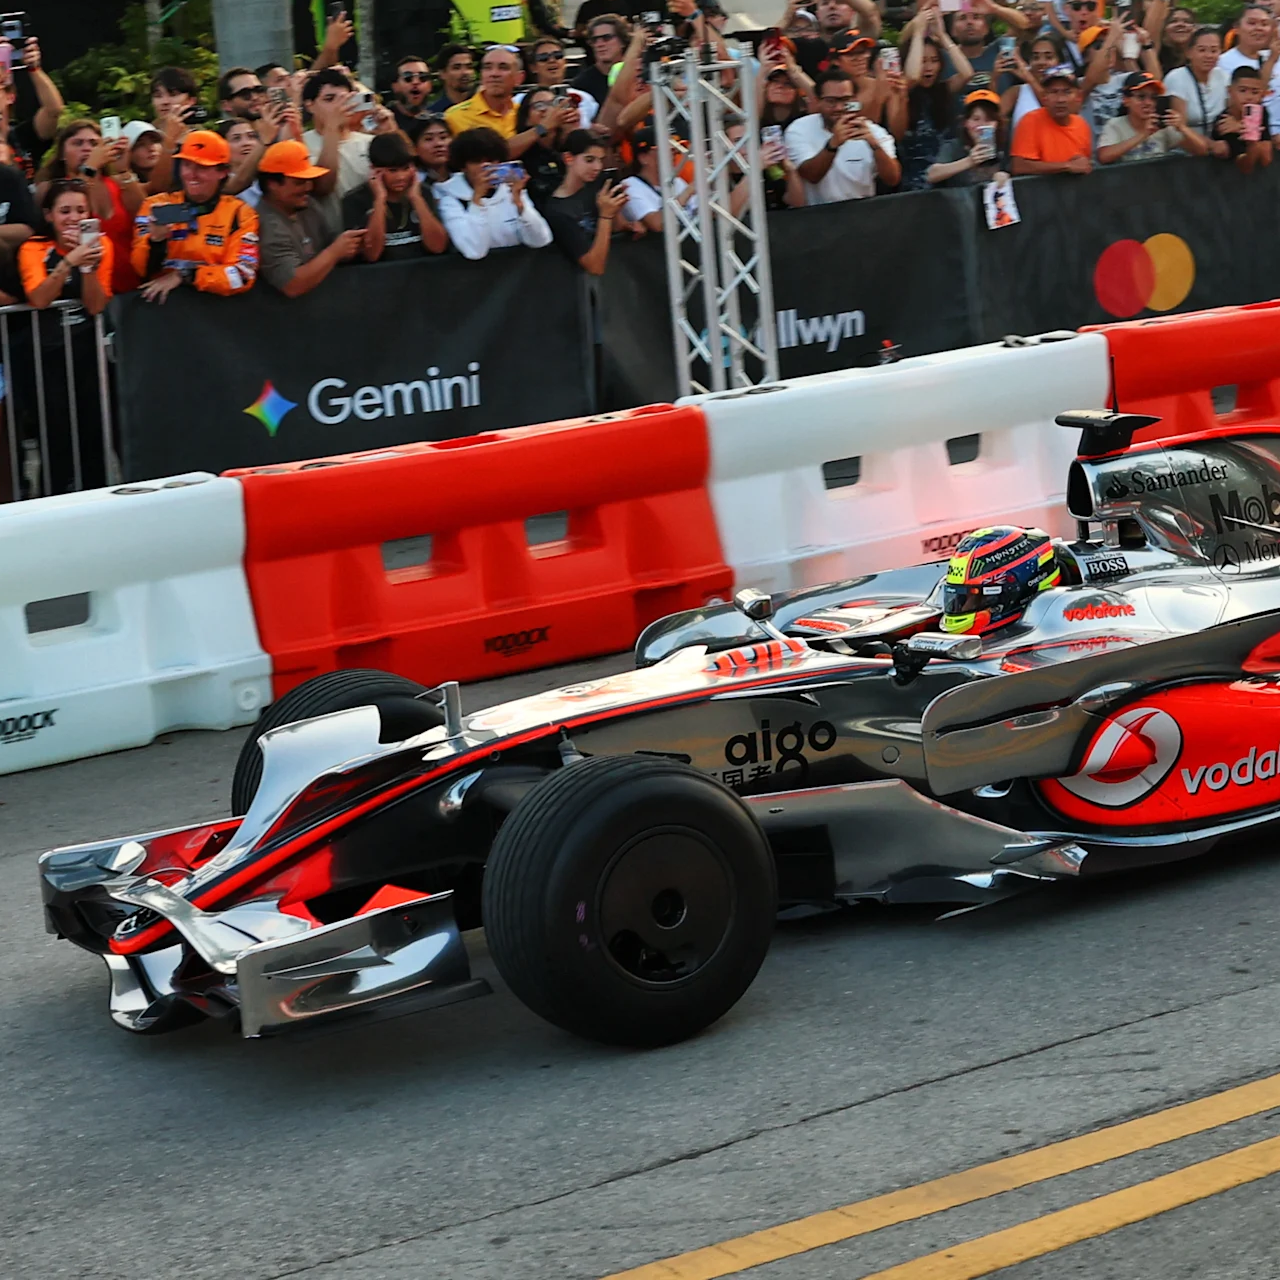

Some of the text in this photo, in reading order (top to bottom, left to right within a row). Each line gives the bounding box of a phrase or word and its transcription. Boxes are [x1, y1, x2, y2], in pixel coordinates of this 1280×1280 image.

[307, 360, 481, 426] Gemini
[1131, 458, 1230, 495] Santander
[985, 539, 1031, 564] MONSTER
[1088, 557, 1127, 575] BOSS
[1063, 601, 1136, 622] vodafone
[483, 625, 553, 654] YODOCK
[725, 719, 838, 788] aigo
